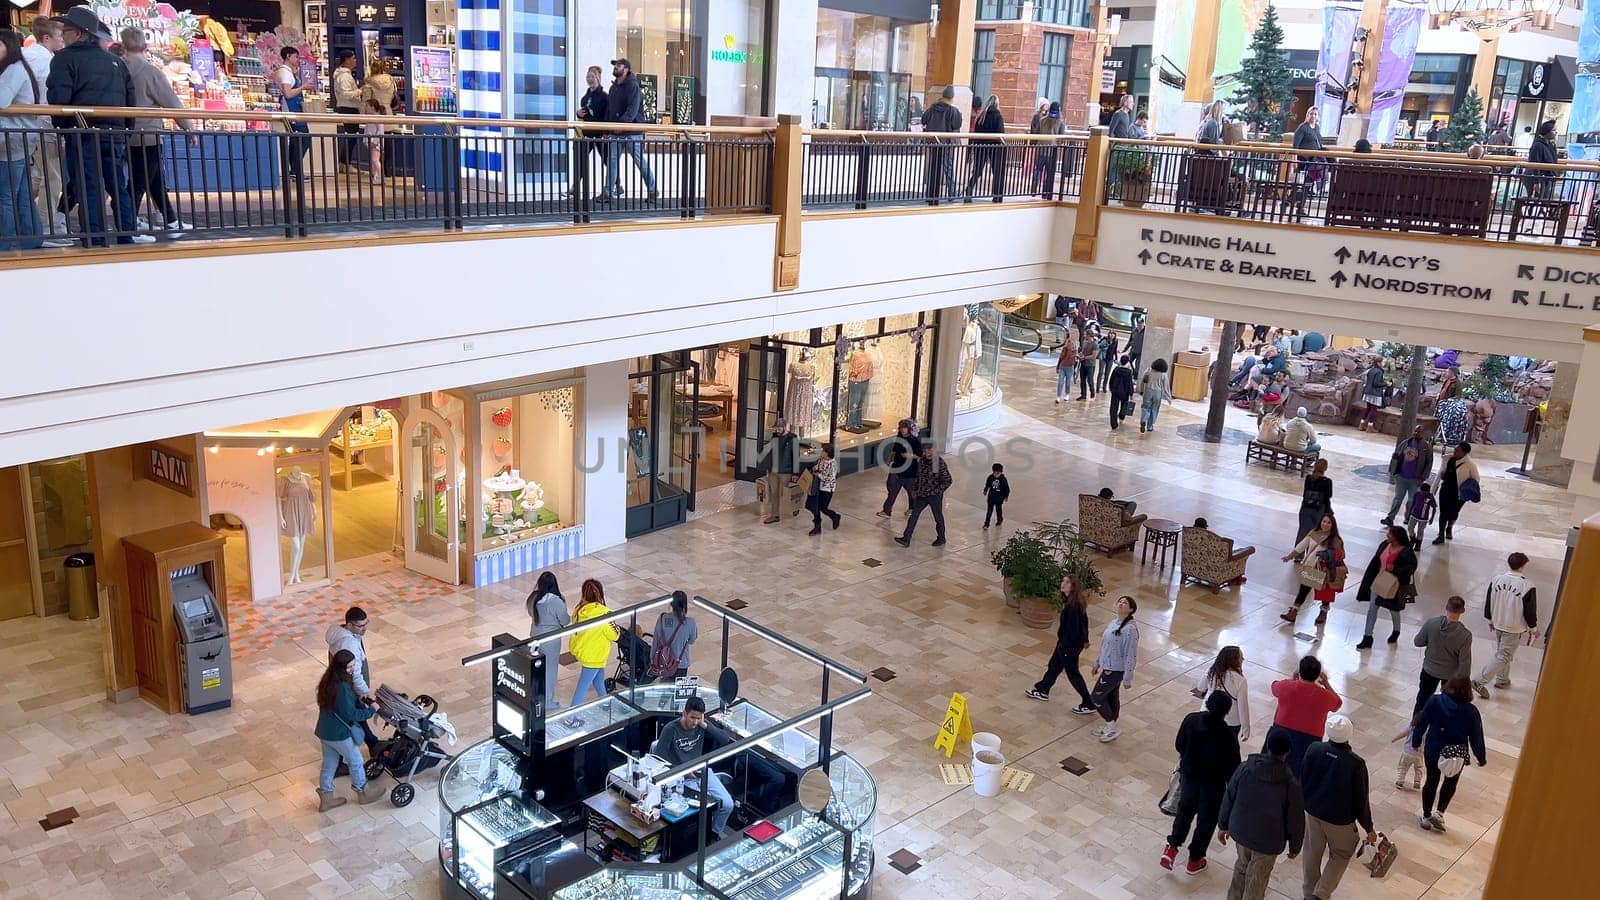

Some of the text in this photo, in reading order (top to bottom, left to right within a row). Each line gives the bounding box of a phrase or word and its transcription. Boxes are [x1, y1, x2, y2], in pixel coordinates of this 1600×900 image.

[103, 16, 170, 29] BRIGHTEST
[711, 50, 747, 64] ROLEX
[1159, 229, 1277, 255] DINING HALL
[1156, 251, 1317, 283] CRATE & BARREL
[1356, 249, 1441, 272] MACY'S
[1353, 272, 1492, 301] NORDSTROM
[1543, 266, 1600, 286] DICK
[1538, 290, 1584, 310] L.L.
[496, 671, 526, 698] Jewelers
